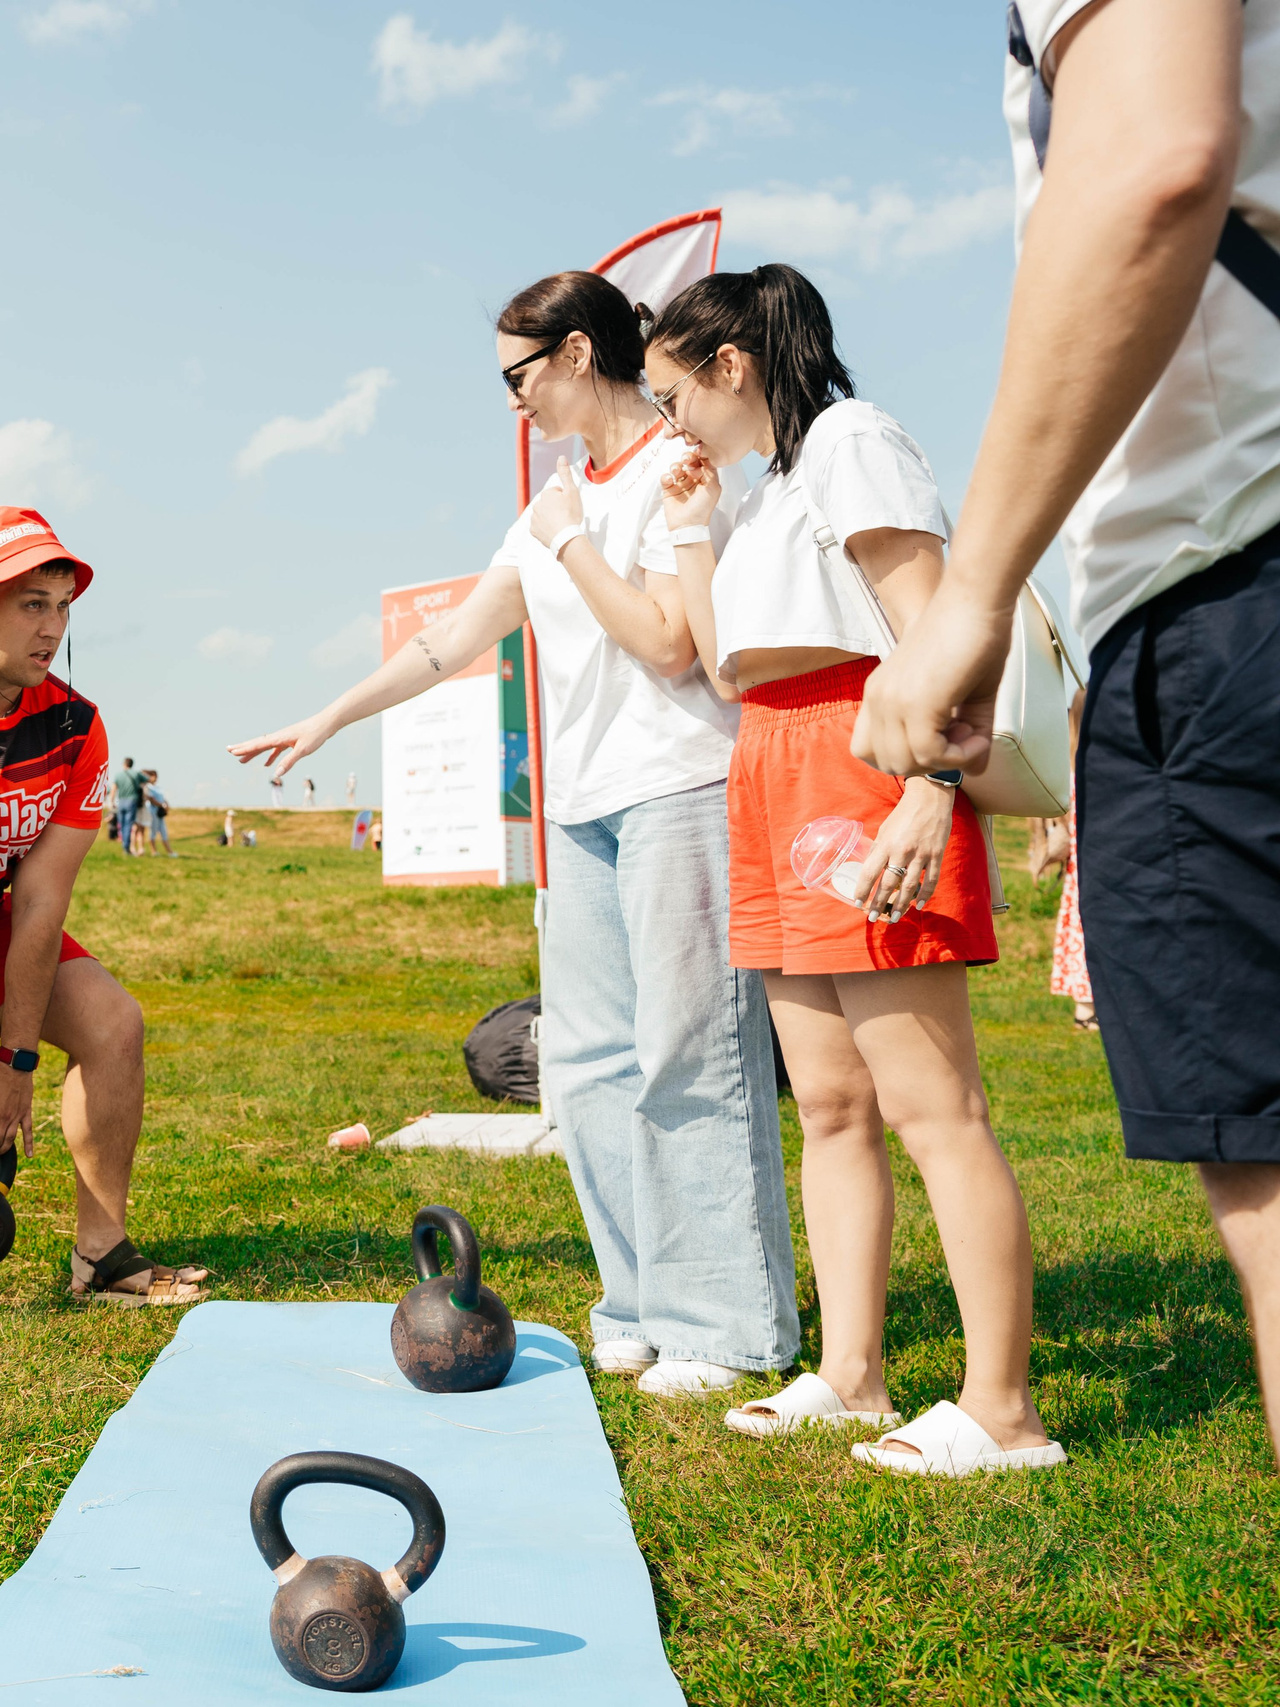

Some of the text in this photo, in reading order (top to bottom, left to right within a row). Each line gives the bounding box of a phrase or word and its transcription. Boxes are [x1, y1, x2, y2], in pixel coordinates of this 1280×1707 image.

[413, 590, 452, 611] SPORT
[307, 1618, 362, 1649] YOUSTEEL
[323, 1662, 341, 1672] KG
